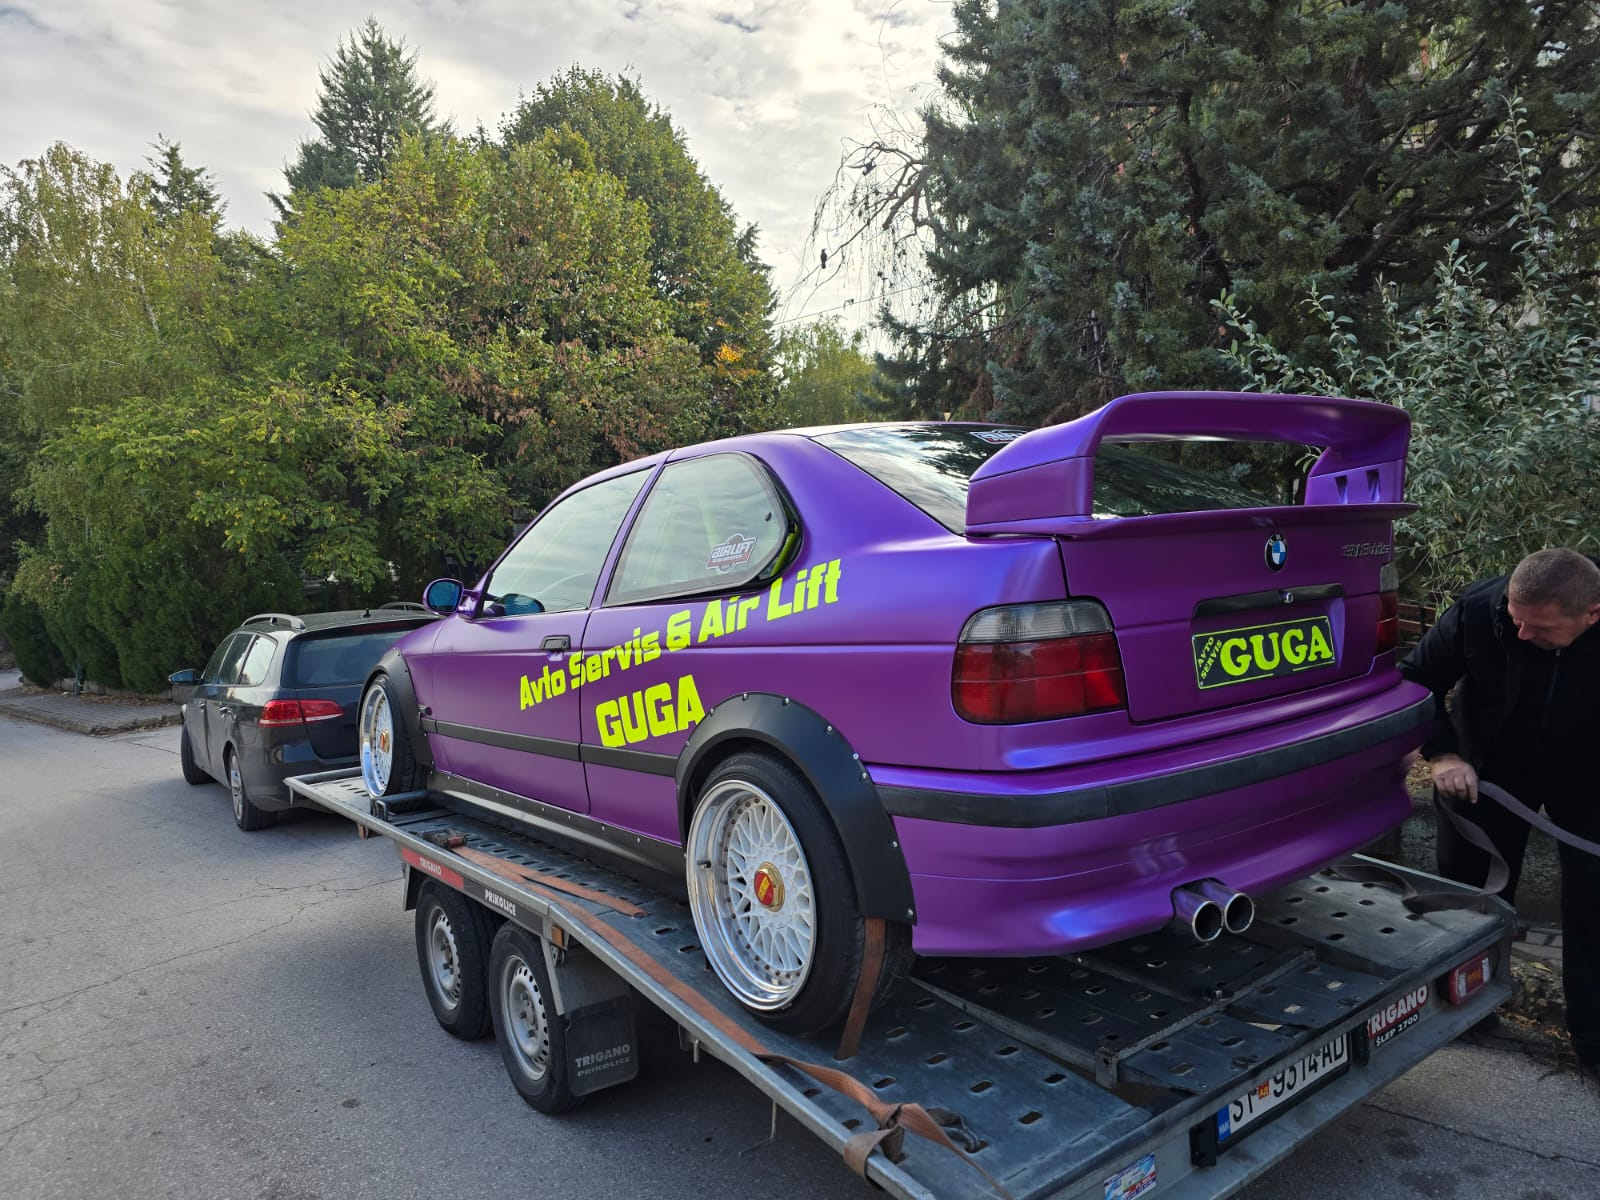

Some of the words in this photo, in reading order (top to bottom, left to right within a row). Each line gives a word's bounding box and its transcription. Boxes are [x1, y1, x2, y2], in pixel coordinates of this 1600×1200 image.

[520, 665, 566, 711] Avto
[568, 627, 662, 690] Servis
[666, 609, 691, 653] &
[698, 595, 760, 644] Air
[767, 559, 841, 621] Lift
[1198, 636, 1214, 668] AVTO
[1220, 625, 1333, 677] GUGA
[1201, 640, 1222, 679] SERVIS
[595, 674, 706, 748] GUGA
[419, 857, 442, 876] TRIGANO
[485, 889, 517, 916] PRIKOLICE
[575, 1043, 631, 1068] TRIGANO
